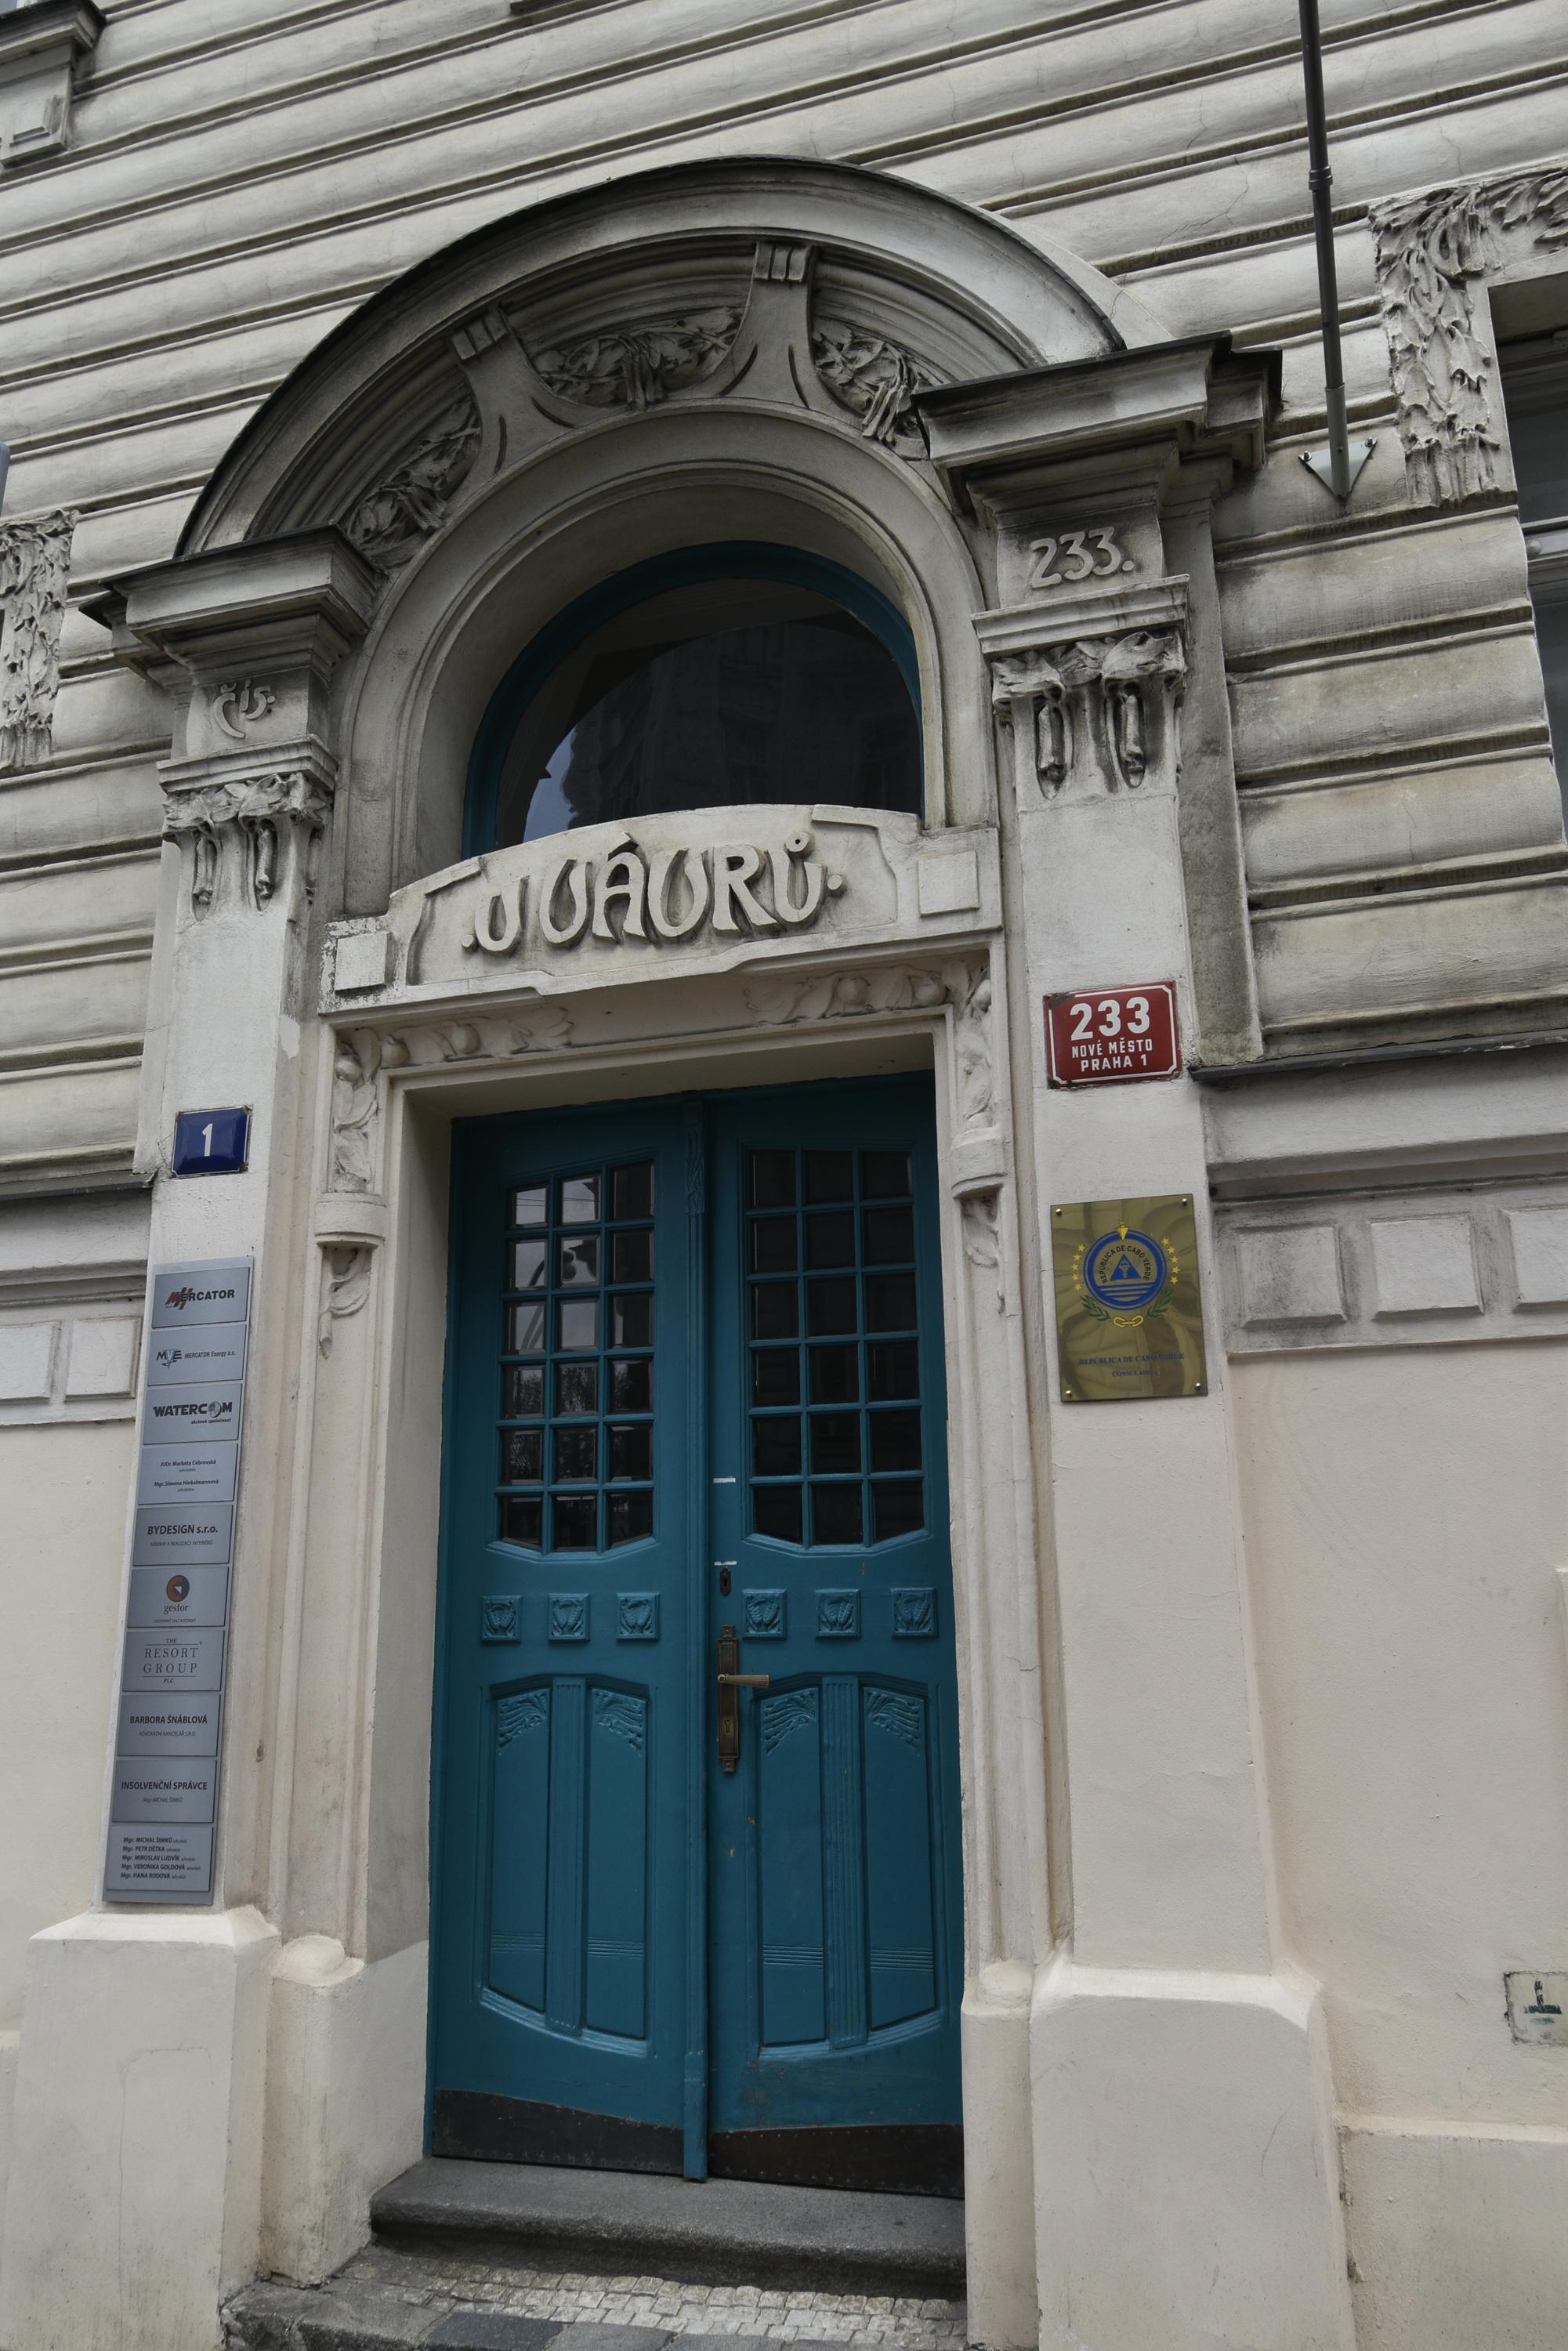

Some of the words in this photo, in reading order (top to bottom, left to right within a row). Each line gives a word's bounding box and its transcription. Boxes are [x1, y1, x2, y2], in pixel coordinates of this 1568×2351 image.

[1070, 996, 1150, 1041] 233
[1071, 1039, 1103, 1058] NOVÉ
[1108, 1037, 1153, 1054] MĚSTO
[1081, 1056, 1132, 1072] PRAHA
[1140, 1054, 1147, 1066] 1
[201, 1123, 213, 1157] 1
[1127, 1245, 1145, 1259] CABO
[1143, 1258, 1151, 1281] VERDE
[165, 1288, 235, 1309] MERCATOR
[153, 1401, 233, 1418] WATERCOM
[147, 1524, 194, 1535] BYDESIGN
[196, 1525, 218, 1534] s.r.o.
[163, 1603, 189, 1615] gestor
[144, 1647, 198, 1658] RESORT
[143, 1663, 197, 1674] GROUP
[129, 1715, 165, 1724] BARBORA
[167, 1713, 208, 1724] ŠNÁBLOVÁ
[121, 1780, 172, 1790] INSOLVENČNÍ
[173, 1780, 208, 1790] SPRÁVCE
